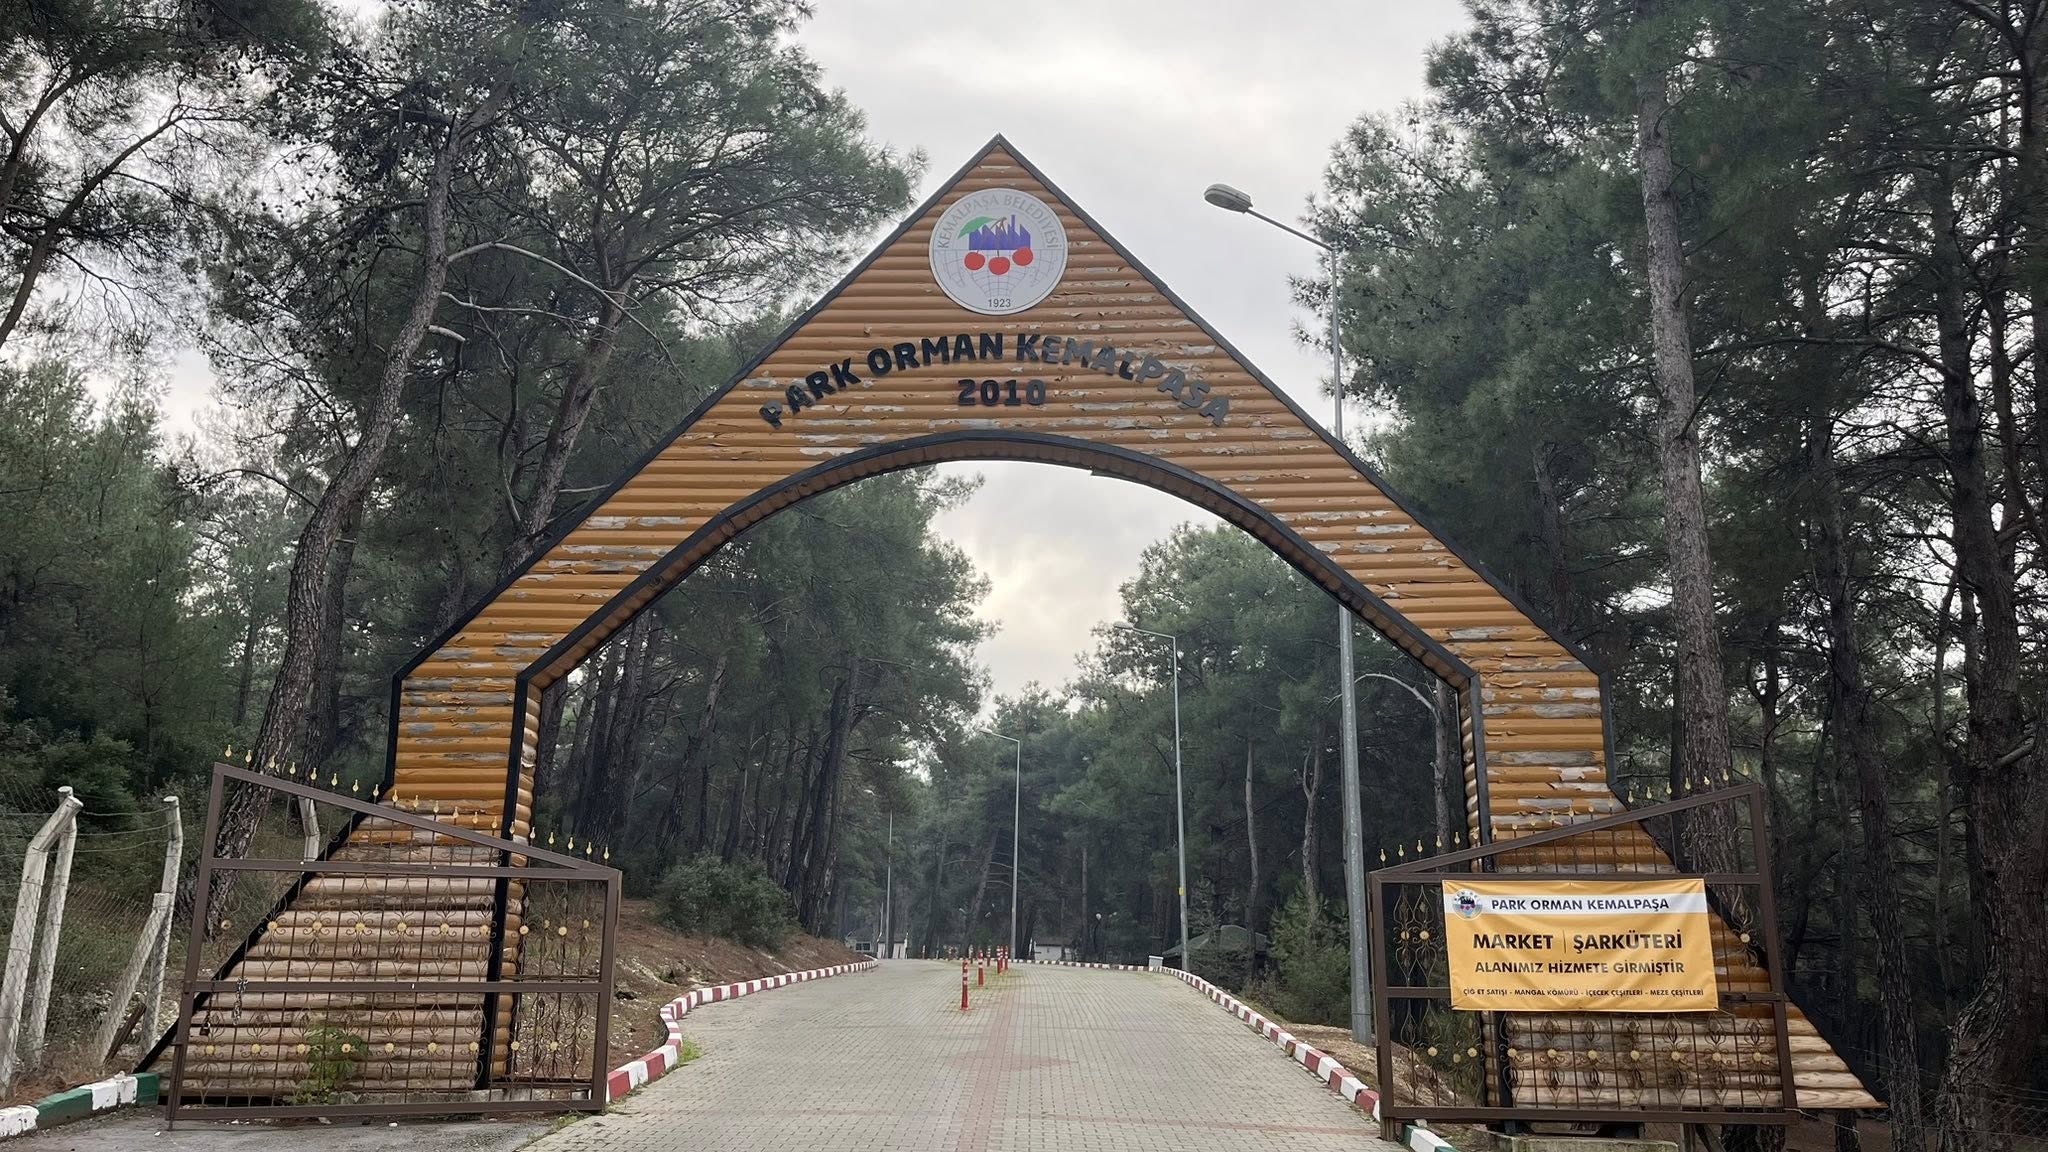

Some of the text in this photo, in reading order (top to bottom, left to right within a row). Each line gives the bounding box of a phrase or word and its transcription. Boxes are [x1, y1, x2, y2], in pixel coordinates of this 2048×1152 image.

[988, 298, 1012, 308] 1923
[759, 357, 863, 430] PARK
[867, 332, 1004, 377] ORMAN
[957, 378, 1046, 407] 2010
[1491, 898, 1669, 912] PARK ORMAN KEMALPAŞA
[1473, 929, 1682, 954] MARKET ŞARKÜTERİ
[1475, 959, 1685, 975] ALANIMIZ HİZMETE GİRMİŞTİR
[1514, 988, 1546, 996] MANGAL
